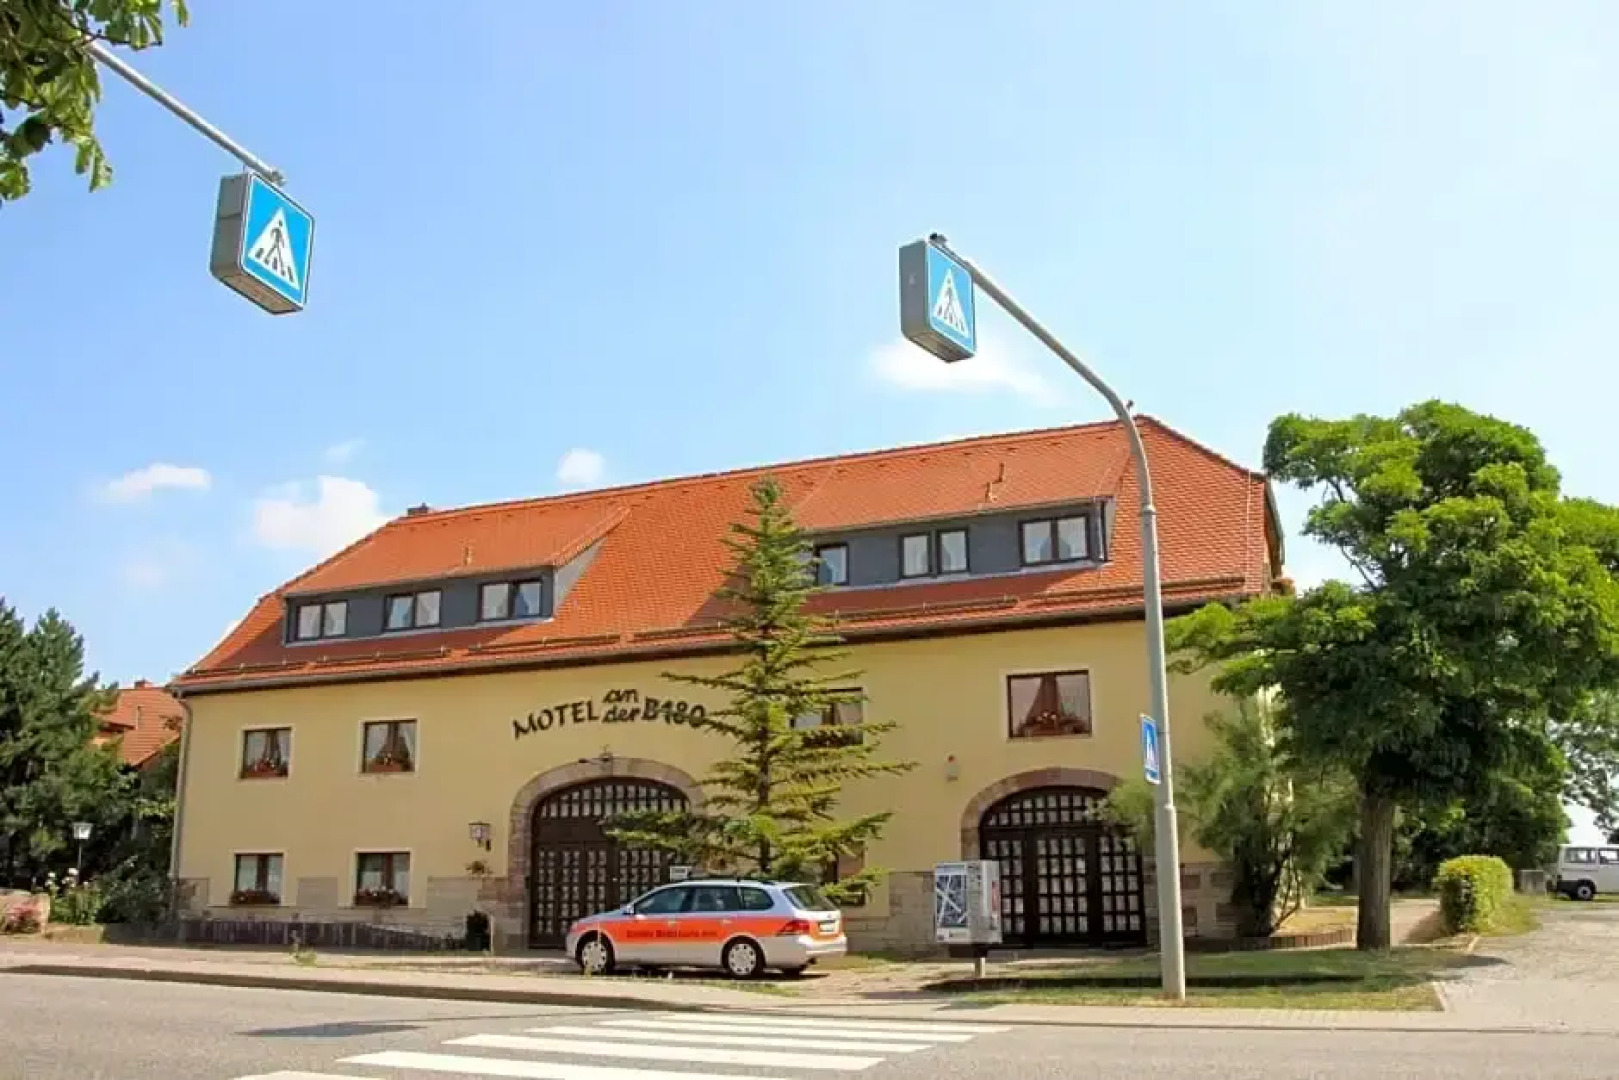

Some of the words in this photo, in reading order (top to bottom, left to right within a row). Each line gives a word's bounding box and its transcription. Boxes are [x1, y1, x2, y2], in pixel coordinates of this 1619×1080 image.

[602, 688, 639, 704] an
[512, 700, 599, 739] MOTEL
[602, 706, 641, 723] der
[641, 697, 706, 729] B180
